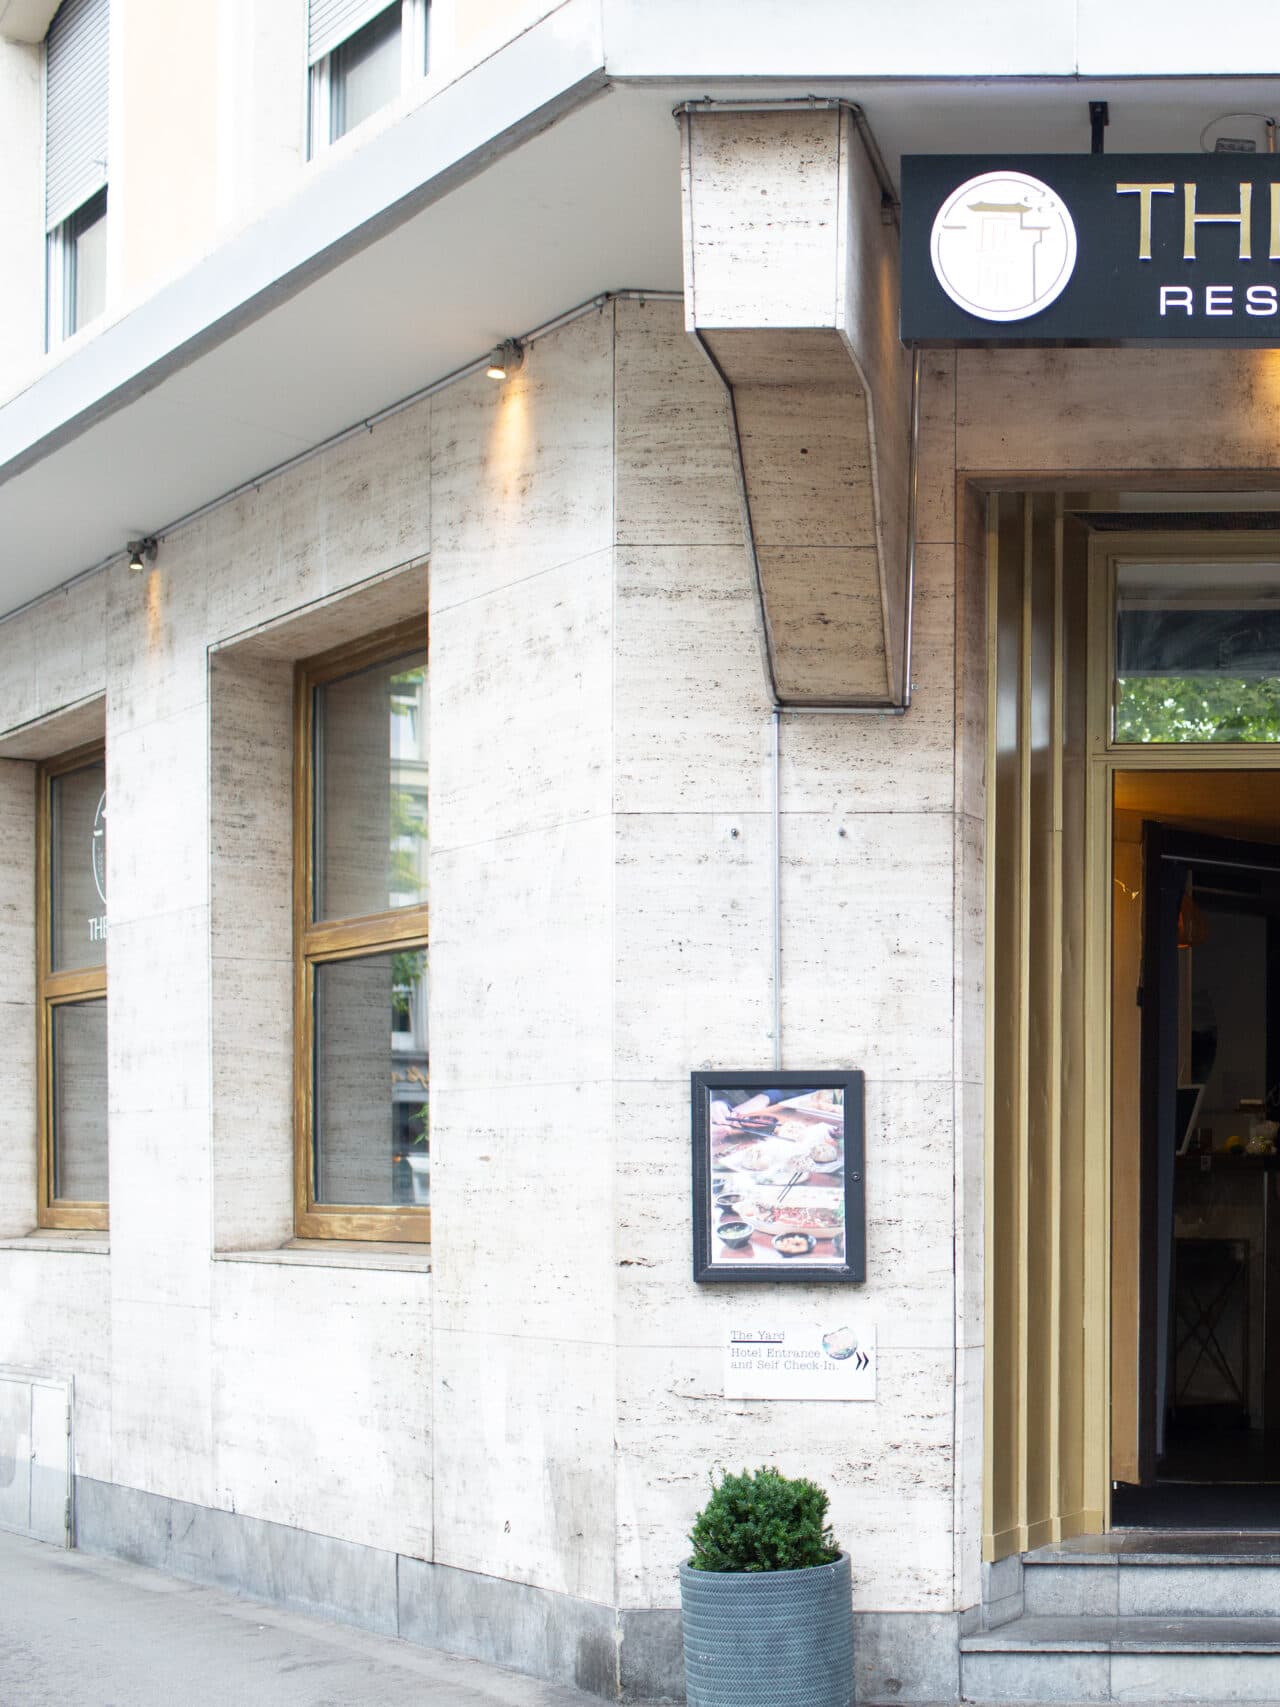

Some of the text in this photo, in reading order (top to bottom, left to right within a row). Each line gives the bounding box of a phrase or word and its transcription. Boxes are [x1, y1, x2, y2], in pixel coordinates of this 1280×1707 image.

[730, 1330, 785, 1340] The Yard
[731, 1348, 821, 1358] Hotel Entrance
[730, 1360, 839, 1371] and Self Check-In.
